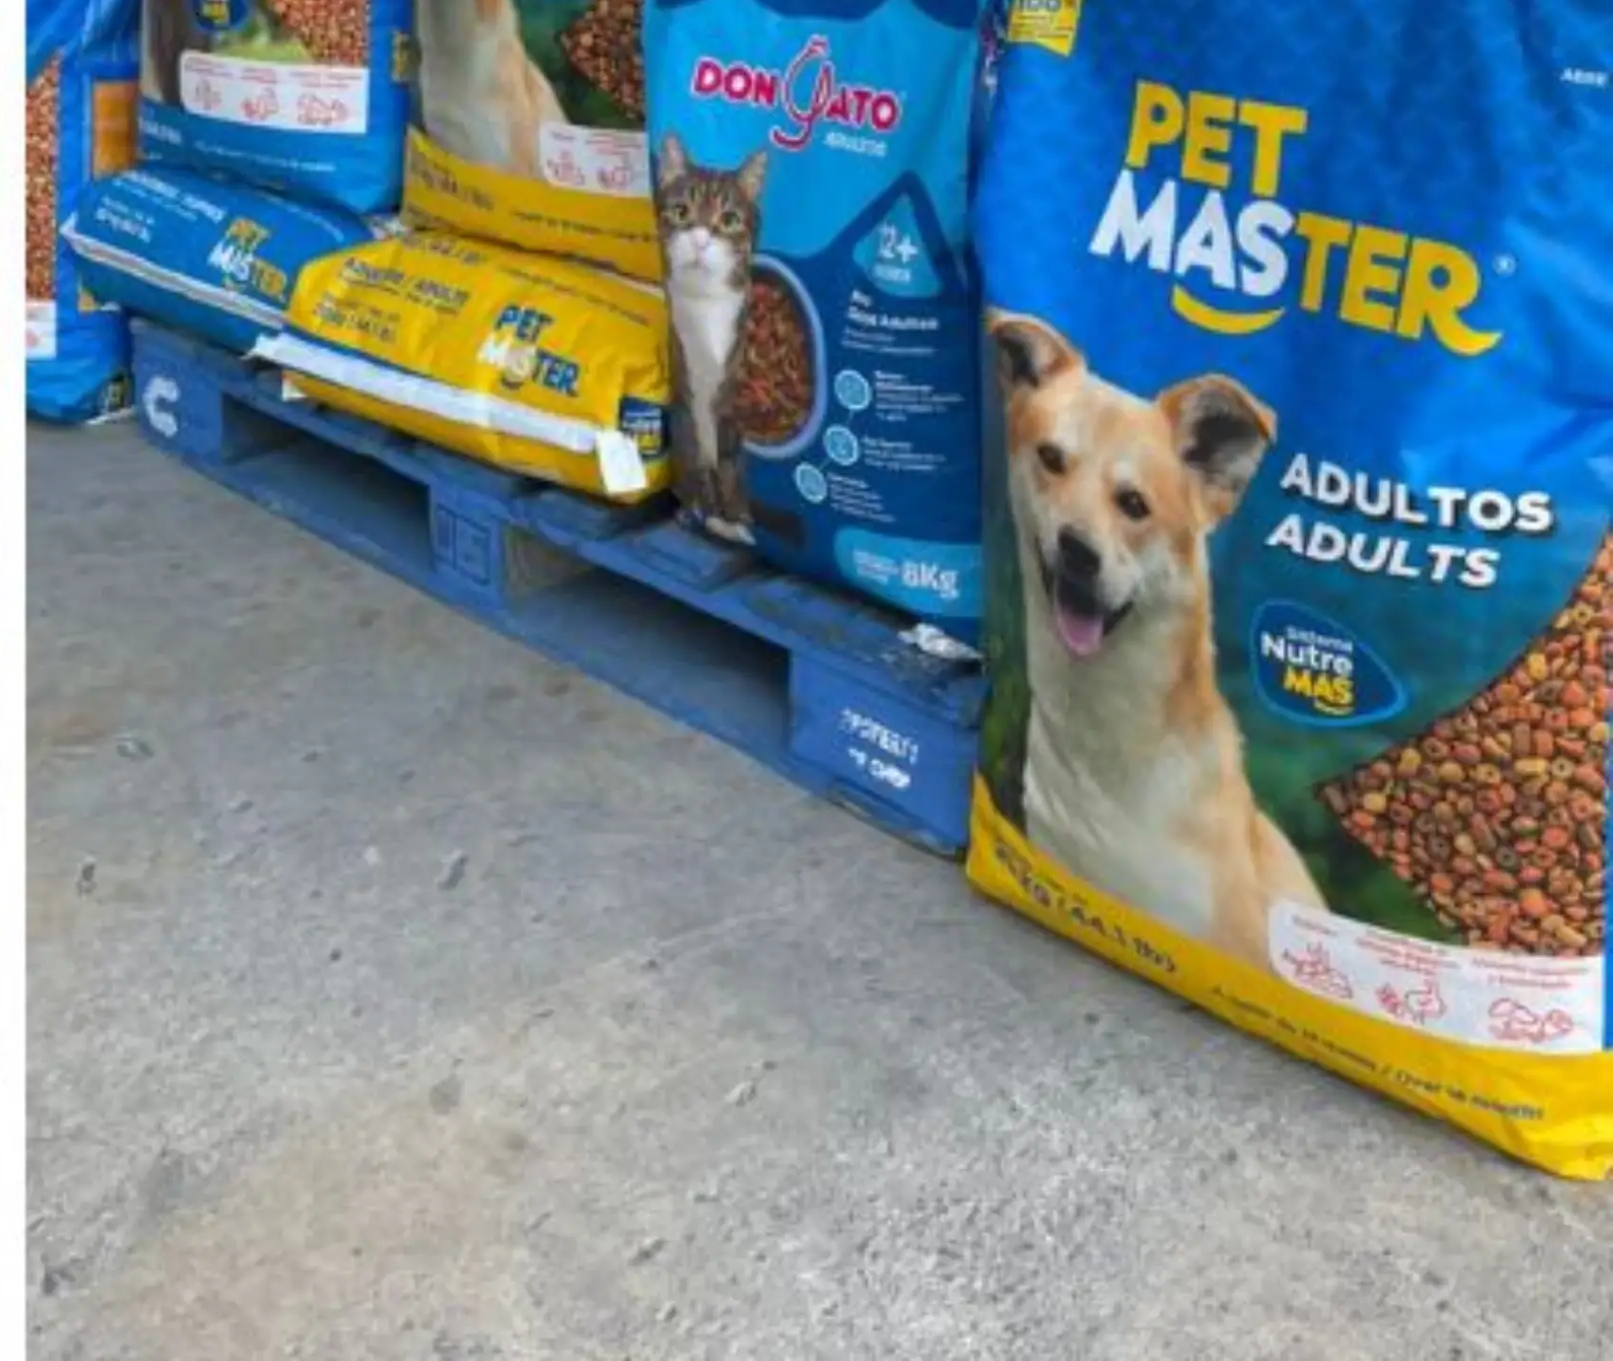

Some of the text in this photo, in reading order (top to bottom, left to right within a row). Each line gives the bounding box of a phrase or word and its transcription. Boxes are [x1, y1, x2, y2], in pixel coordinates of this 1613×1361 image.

[691, 56, 779, 107] DON
[1125, 79, 1308, 198] PET
[1088, 168, 1504, 357] MASTER
[493, 304, 553, 341] PET
[1280, 451, 1556, 533] ADULTOS
[1265, 513, 1501, 589] ADULTS
